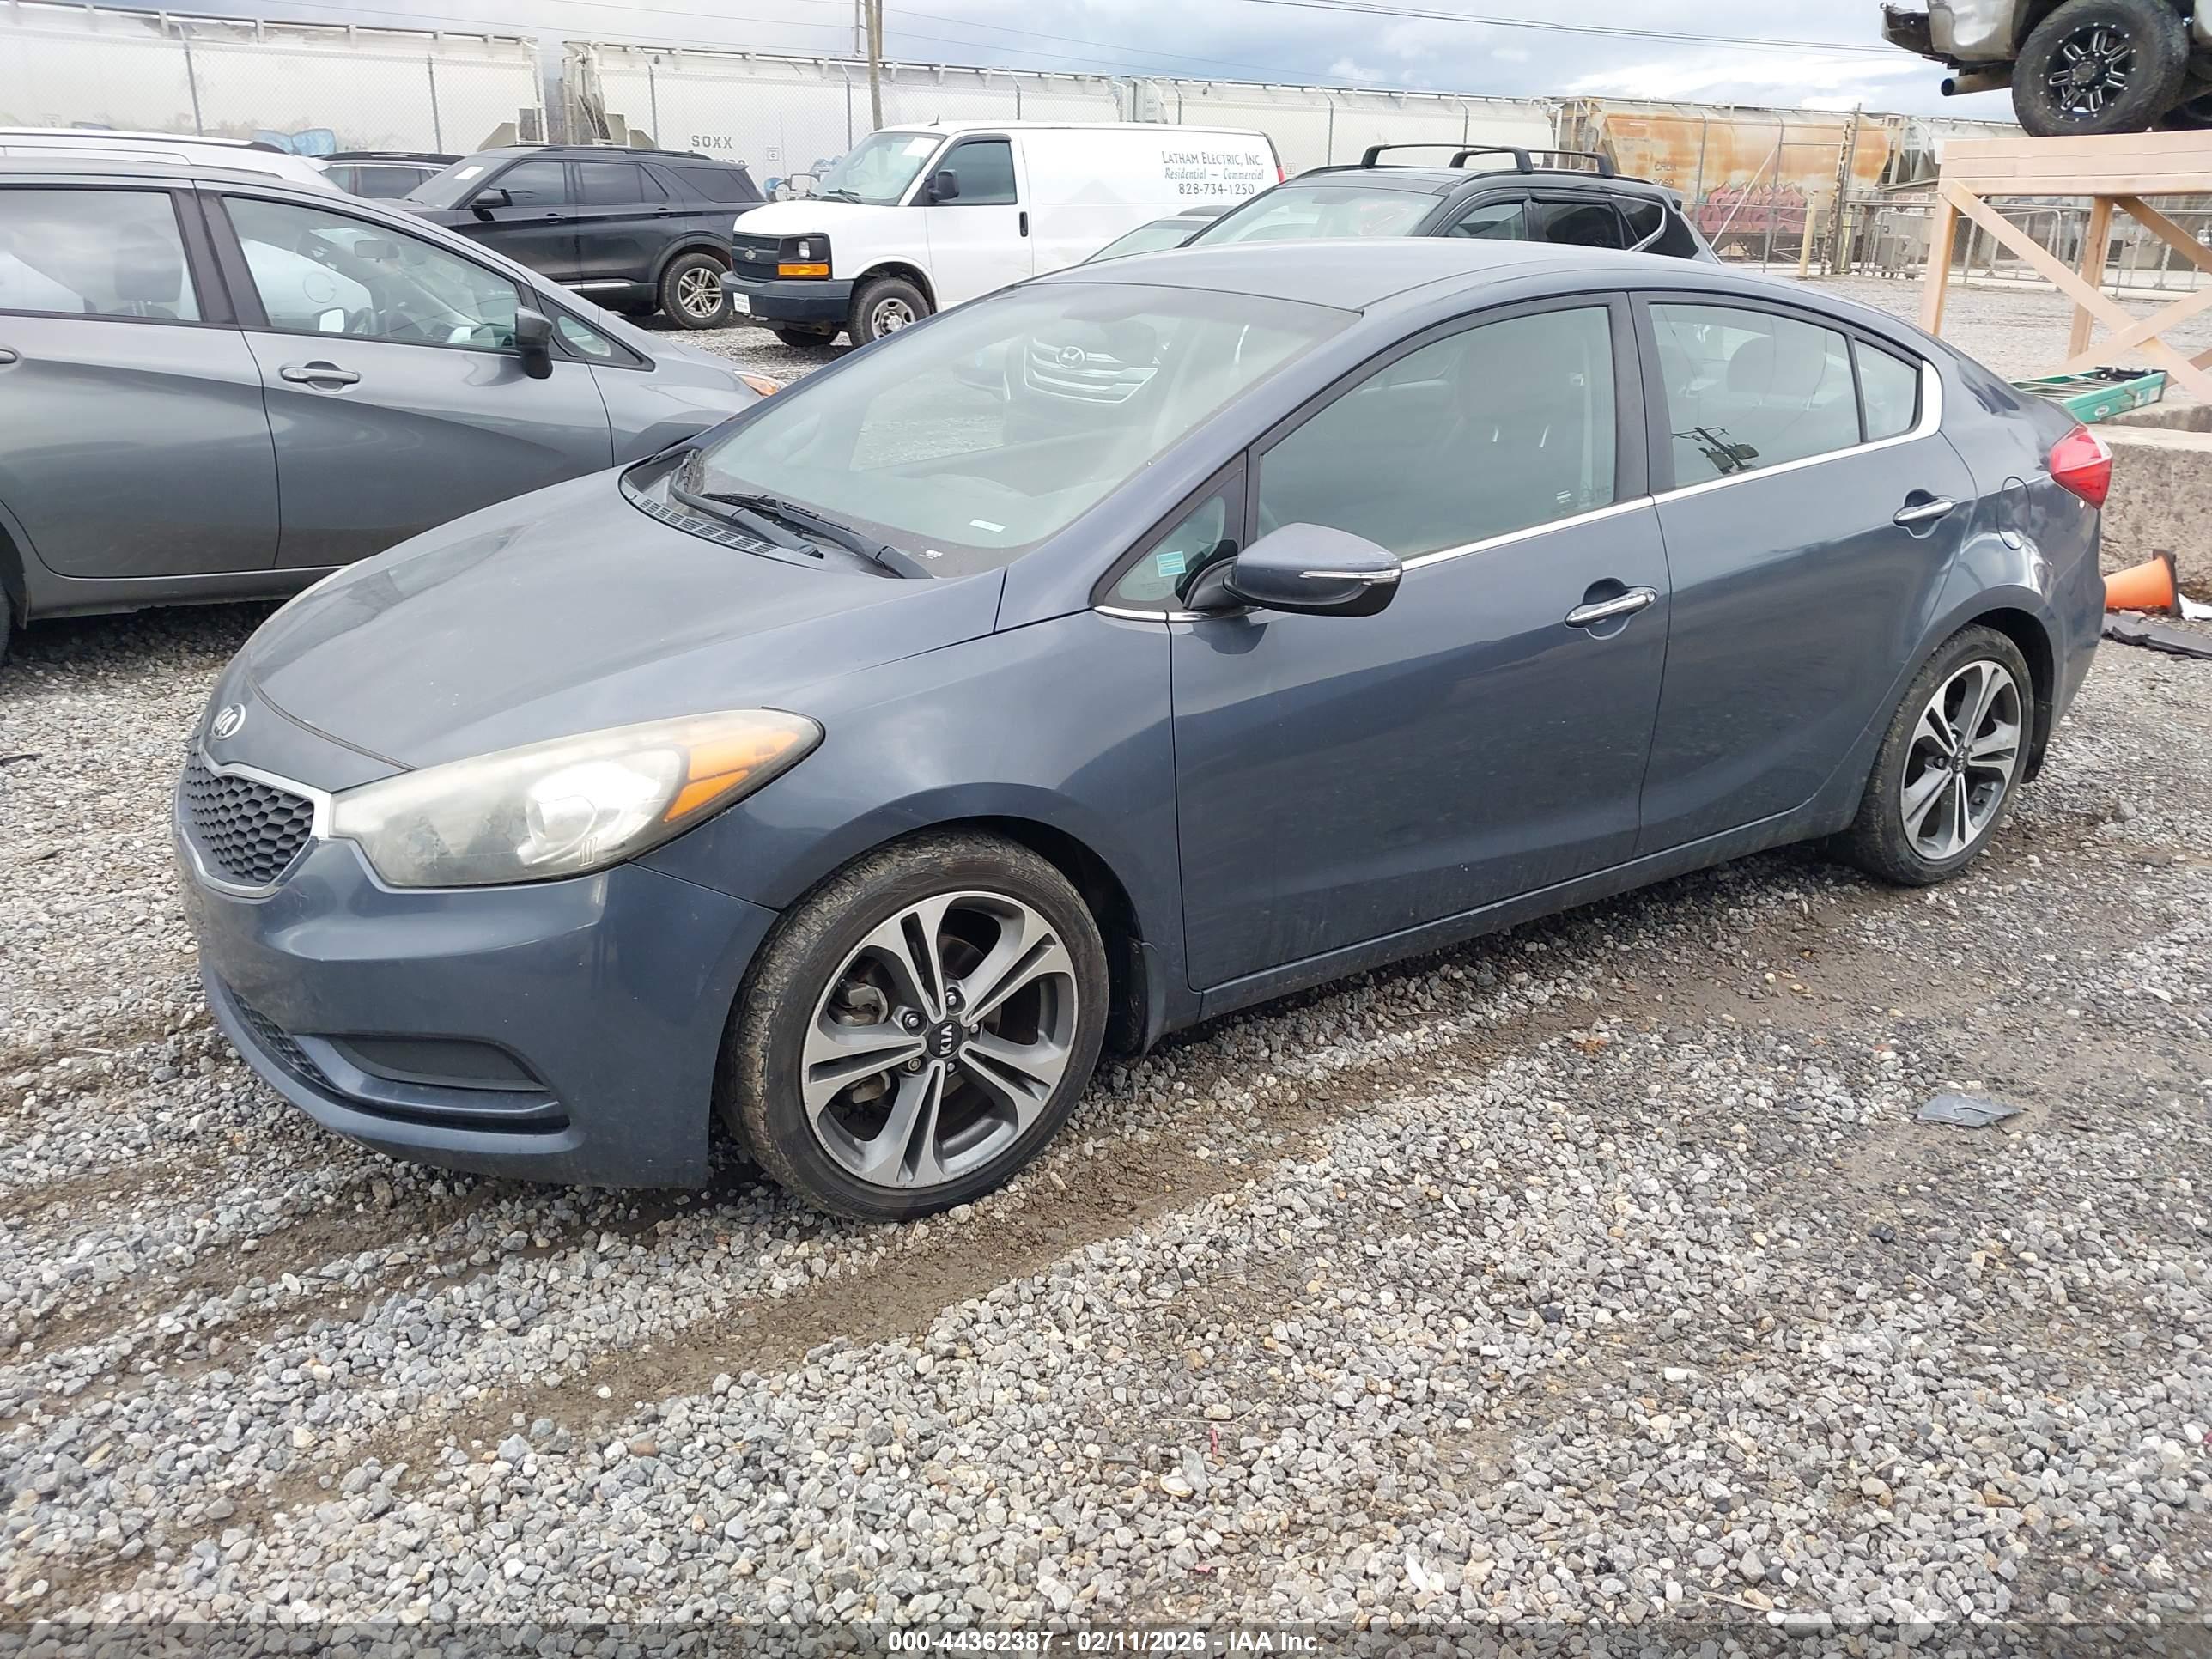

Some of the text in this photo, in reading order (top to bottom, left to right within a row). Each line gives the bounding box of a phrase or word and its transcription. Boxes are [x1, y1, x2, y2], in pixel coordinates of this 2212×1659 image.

[691, 135, 732, 149] SOXX
[1162, 150, 1263, 167] LATHAM ELECTRIC, INC.
[1164, 167, 1206, 179] Residential
[1223, 167, 1264, 180] Commercial
[1178, 183, 1255, 195] 828-734-1250
[939, 1024, 953, 1055] KIA
